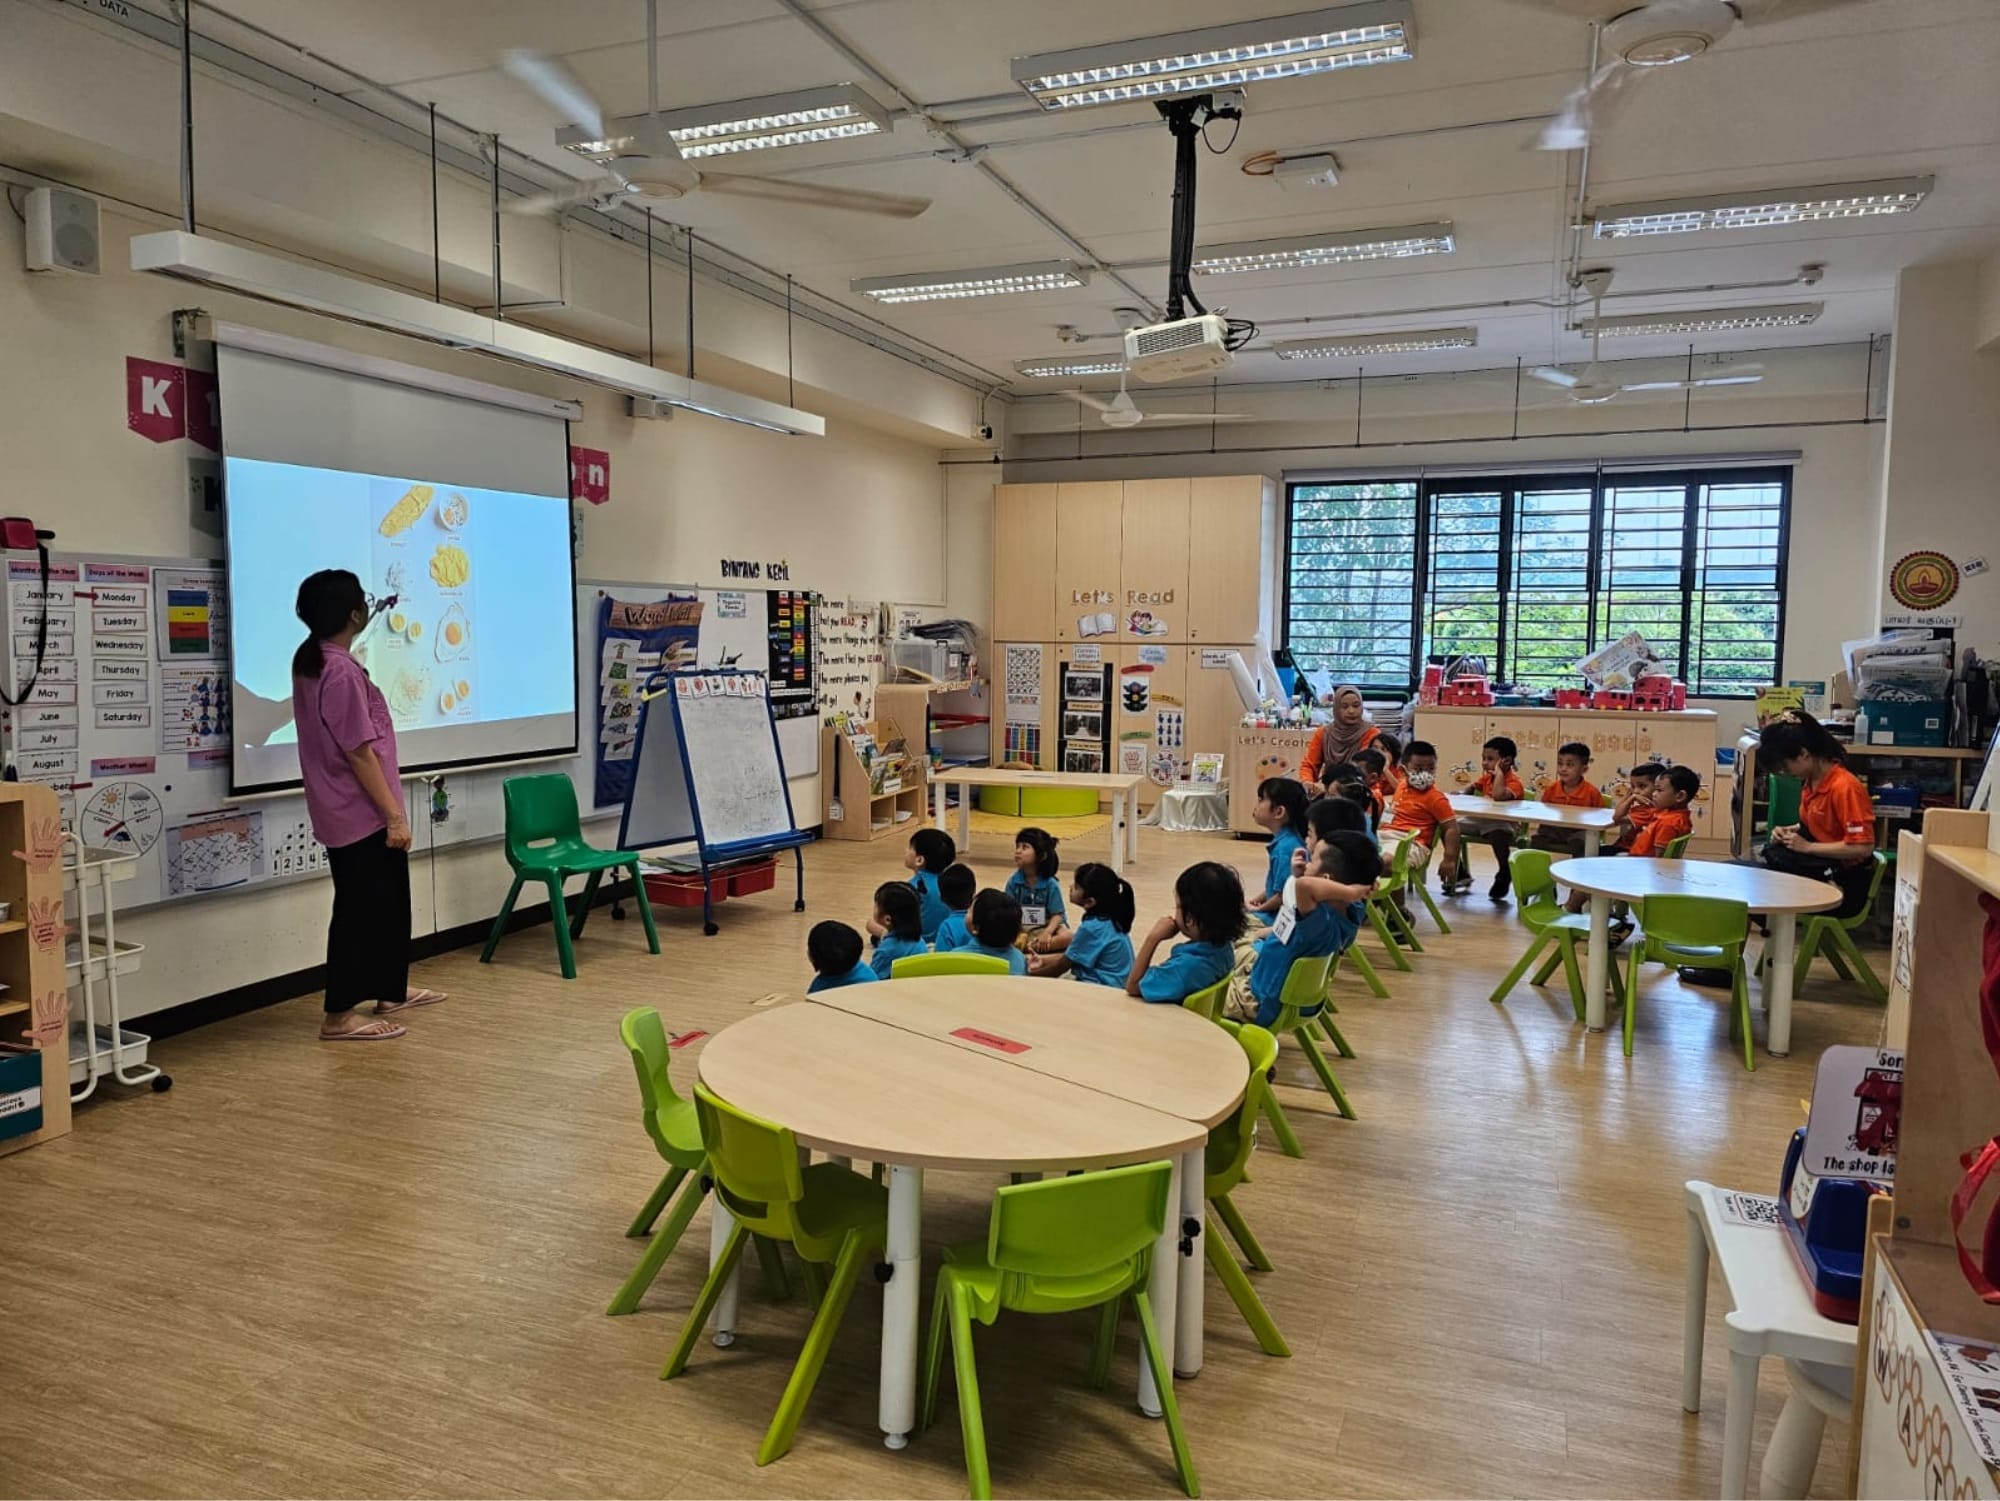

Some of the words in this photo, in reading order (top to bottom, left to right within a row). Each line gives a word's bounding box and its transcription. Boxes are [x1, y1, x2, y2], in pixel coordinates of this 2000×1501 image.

[721, 559, 760, 579] BINTANG
[26, 591, 63, 601] Janary
[102, 593, 136, 603] Monday
[1072, 589, 1115, 604] Let's
[1127, 589, 1175, 605] Read
[624, 603, 669, 625] Word
[23, 616, 66, 627] Febuary
[103, 617, 137, 627] Tuesday
[29, 641, 59, 650] Mrch
[95, 641, 144, 651] Wednesday
[102, 665, 140, 675] Thursday
[38, 689, 59, 699] May
[106, 690, 134, 699] Friday
[40, 713, 59, 721] June
[104, 713, 143, 722] Saturday
[40, 734, 58, 744] July
[1239, 735, 1265, 745] Let's
[33, 759, 64, 769] August
[284, 858, 291, 869] 2
[297, 856, 304, 866] 3
[309, 853, 316, 863] 4
[1823, 1156, 1845, 1170] The
[1848, 1158, 1878, 1175] shop
